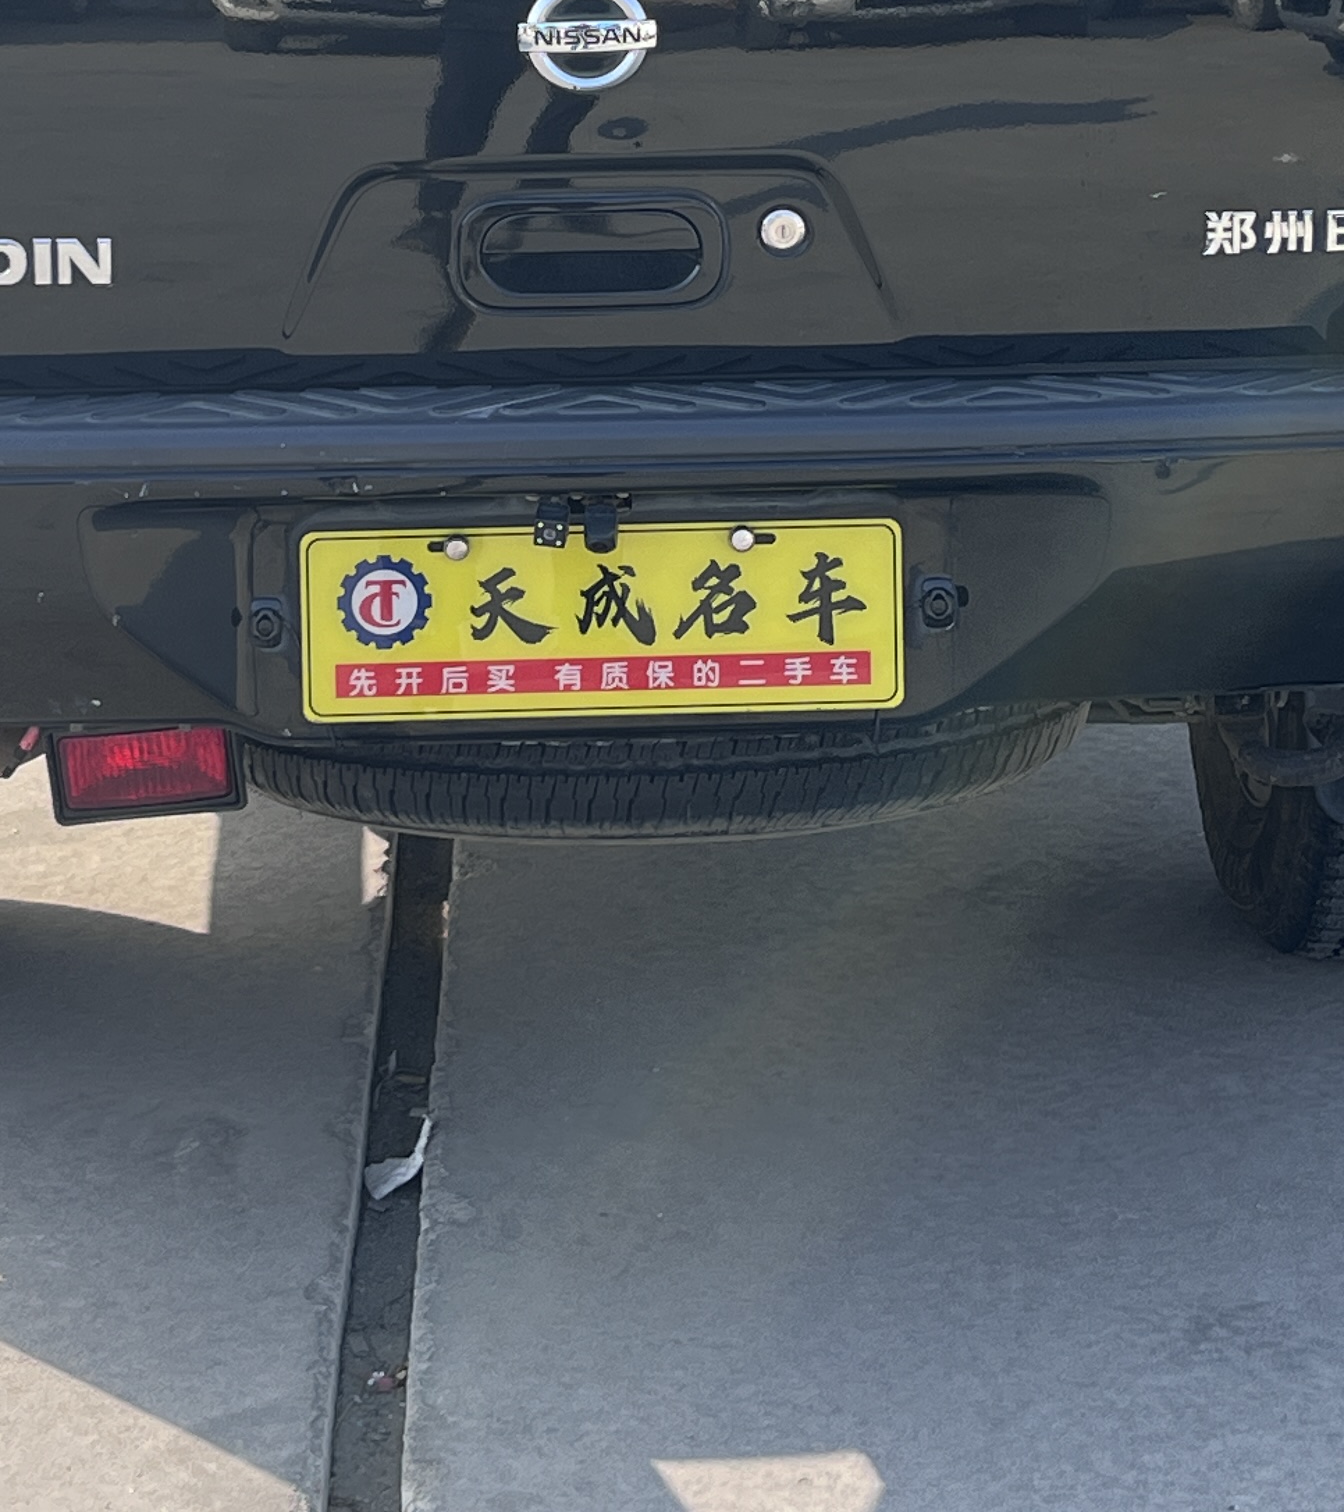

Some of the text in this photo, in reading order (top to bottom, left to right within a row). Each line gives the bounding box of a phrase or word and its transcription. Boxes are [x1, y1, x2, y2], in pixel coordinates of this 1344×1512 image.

[533, 27, 642, 46] NISSAN
[469, 551, 867, 646] 天成名车
